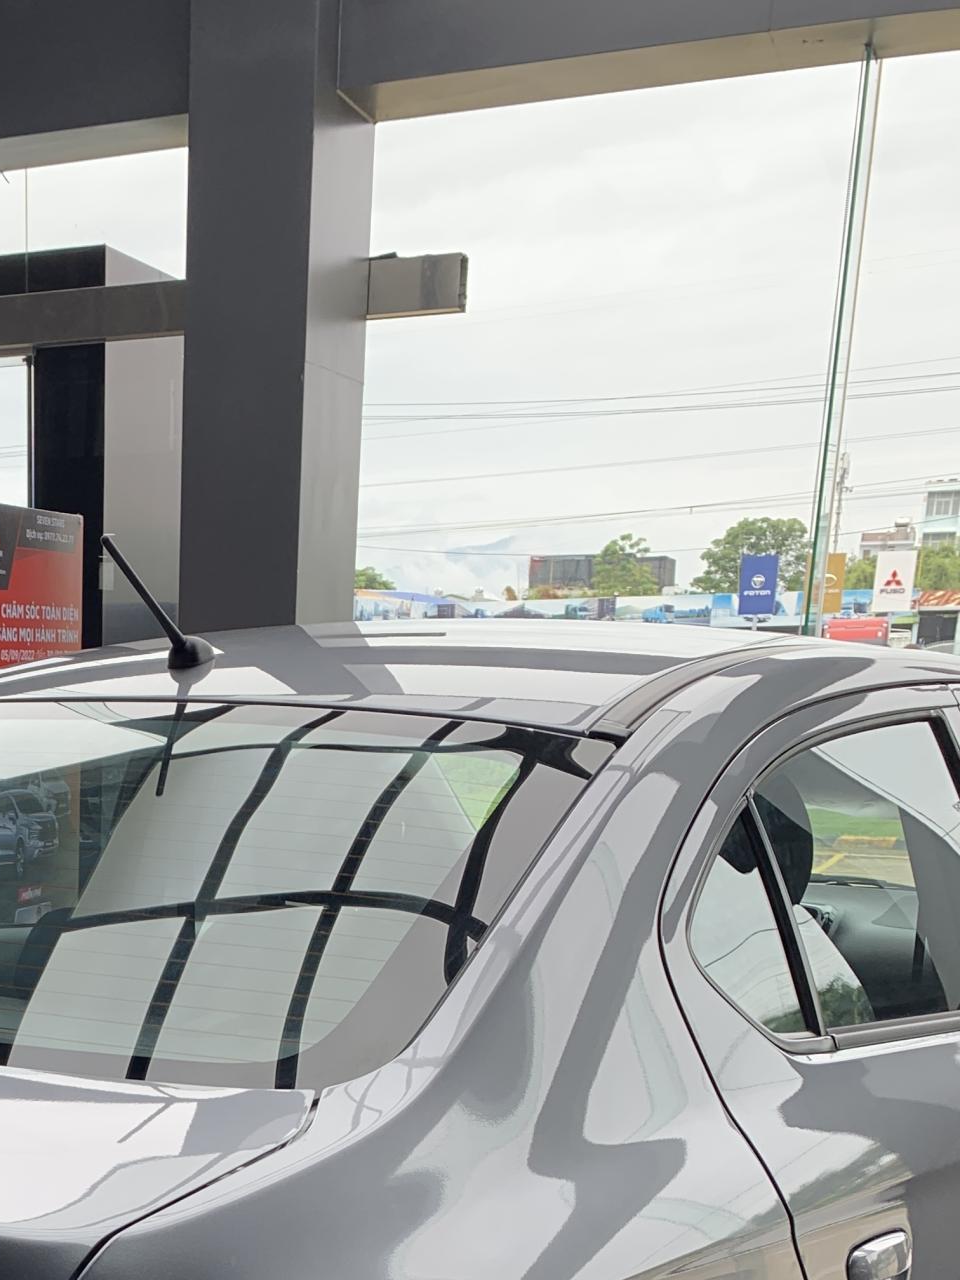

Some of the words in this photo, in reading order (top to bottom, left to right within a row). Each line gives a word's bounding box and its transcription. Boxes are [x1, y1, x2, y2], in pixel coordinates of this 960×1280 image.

[879, 587, 905, 595] FUSO
[1, 600, 25, 619] CHĂM
[25, 601, 40, 619] SÓC
[19, 627, 34, 646] MỌI
